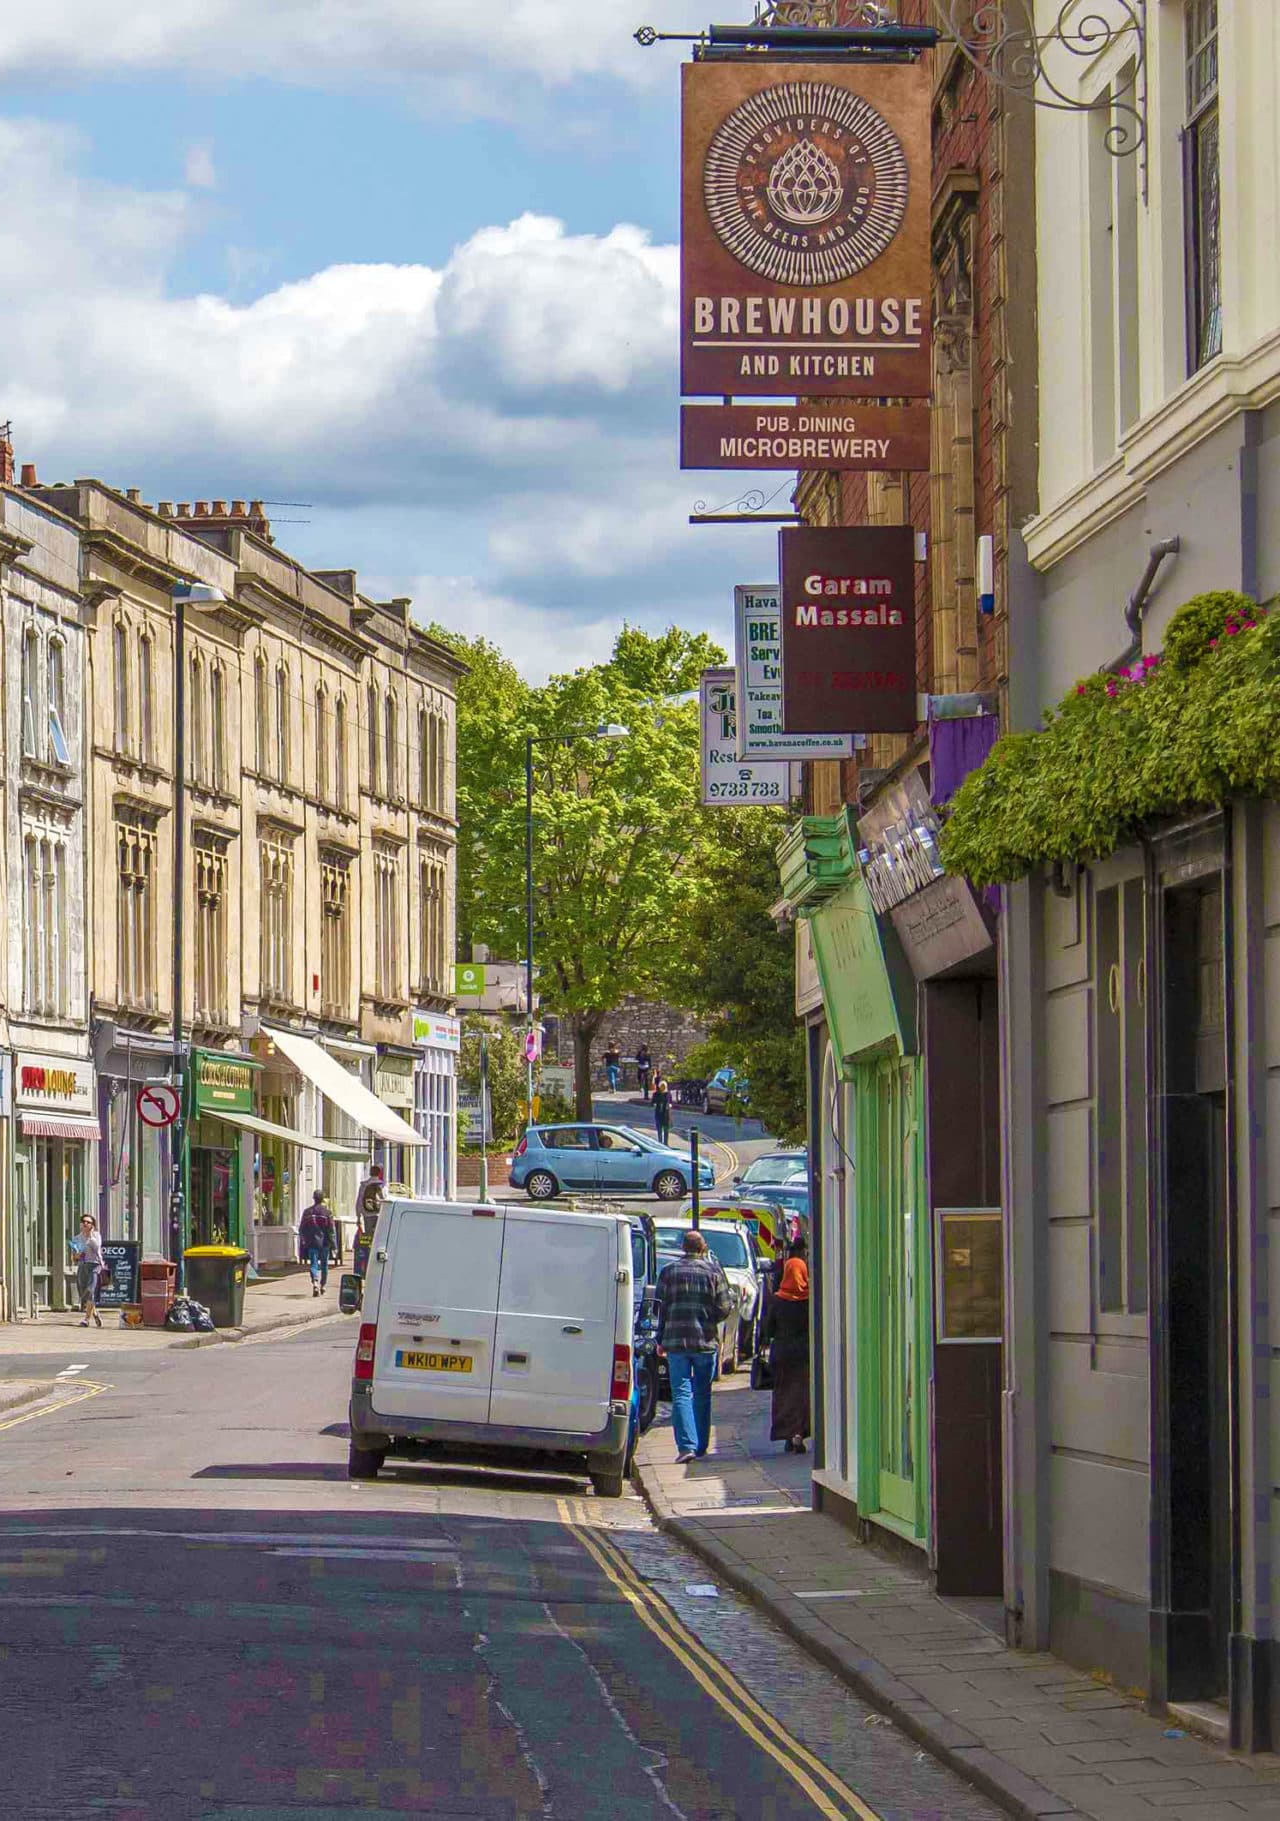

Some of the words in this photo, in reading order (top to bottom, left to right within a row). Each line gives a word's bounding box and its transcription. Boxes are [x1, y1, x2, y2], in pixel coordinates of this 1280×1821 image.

[746, 119, 842, 165] PROVIDERS
[849, 144, 867, 165] OF
[742, 185, 763, 221] FINE
[763, 221, 809, 248] BEERS
[818, 225, 846, 245] AND
[848, 186, 870, 224] FOOD
[694, 296, 923, 336] BREWHOUSE
[740, 355, 780, 376] AND
[790, 355, 876, 377] KITCHEN
[720, 438, 891, 459] MICROBREWERY
[804, 575, 893, 595] Garam
[795, 604, 903, 626] Massala
[749, 622, 779, 642] BRE
[709, 782, 748, 797] 9733
[751, 782, 780, 797] 733
[407, 1352, 437, 1367] WK10
[440, 1356, 467, 1369] WPY
